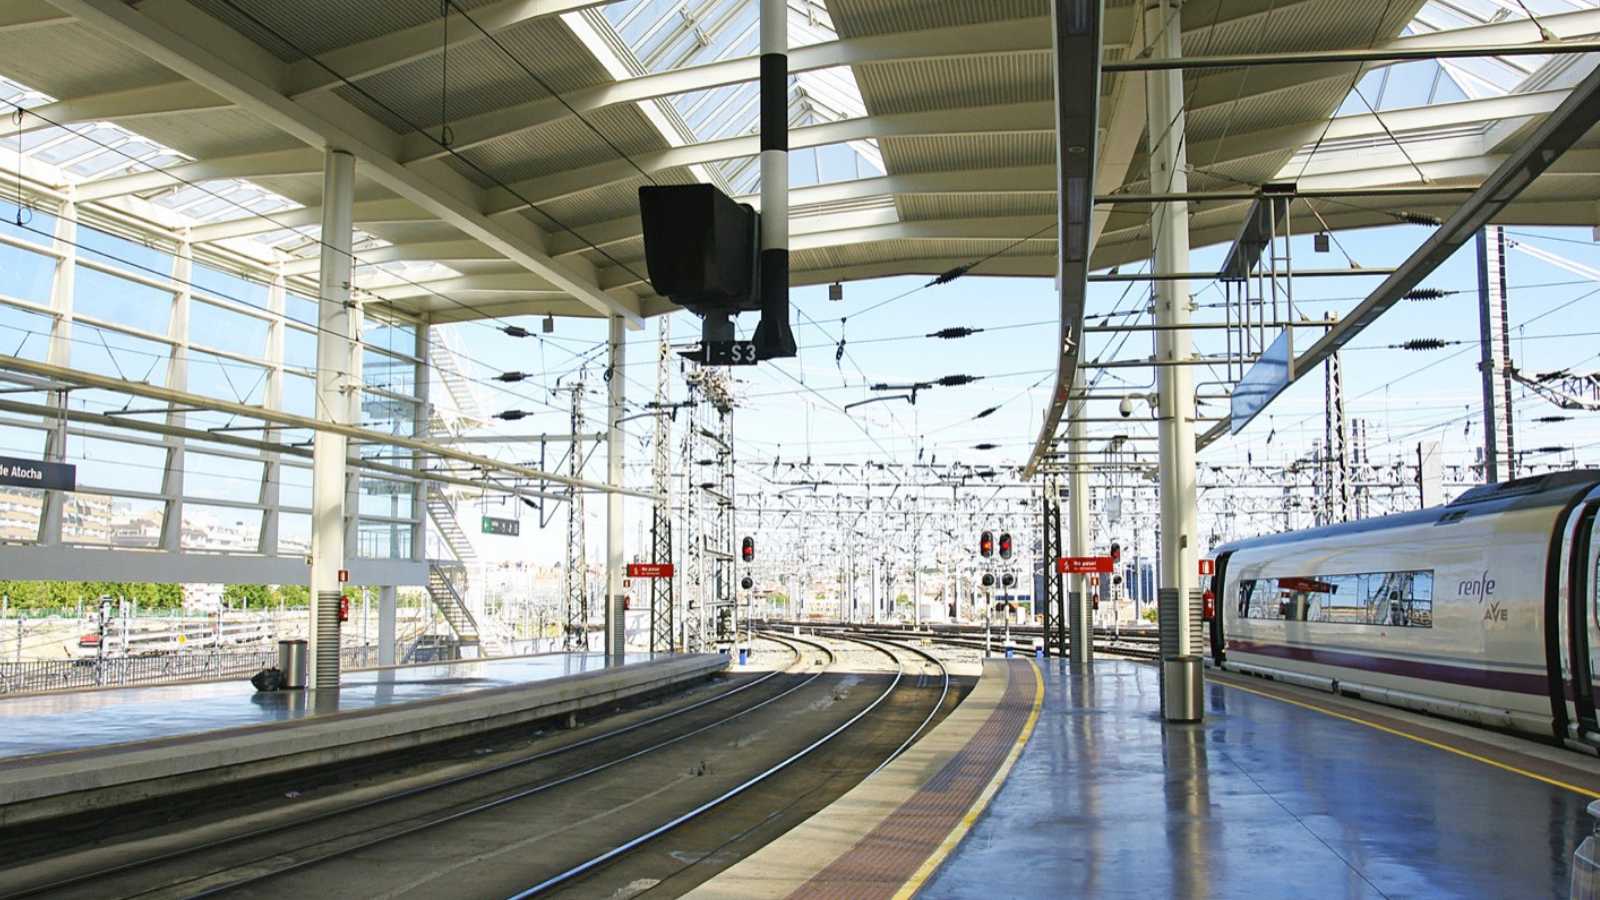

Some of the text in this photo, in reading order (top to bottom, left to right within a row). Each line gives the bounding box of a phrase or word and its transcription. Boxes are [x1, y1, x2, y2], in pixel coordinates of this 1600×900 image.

[11, 466, 42, 480] Atocha
[1458, 569, 1495, 604] renfe
[1484, 601, 1508, 622] AVE
